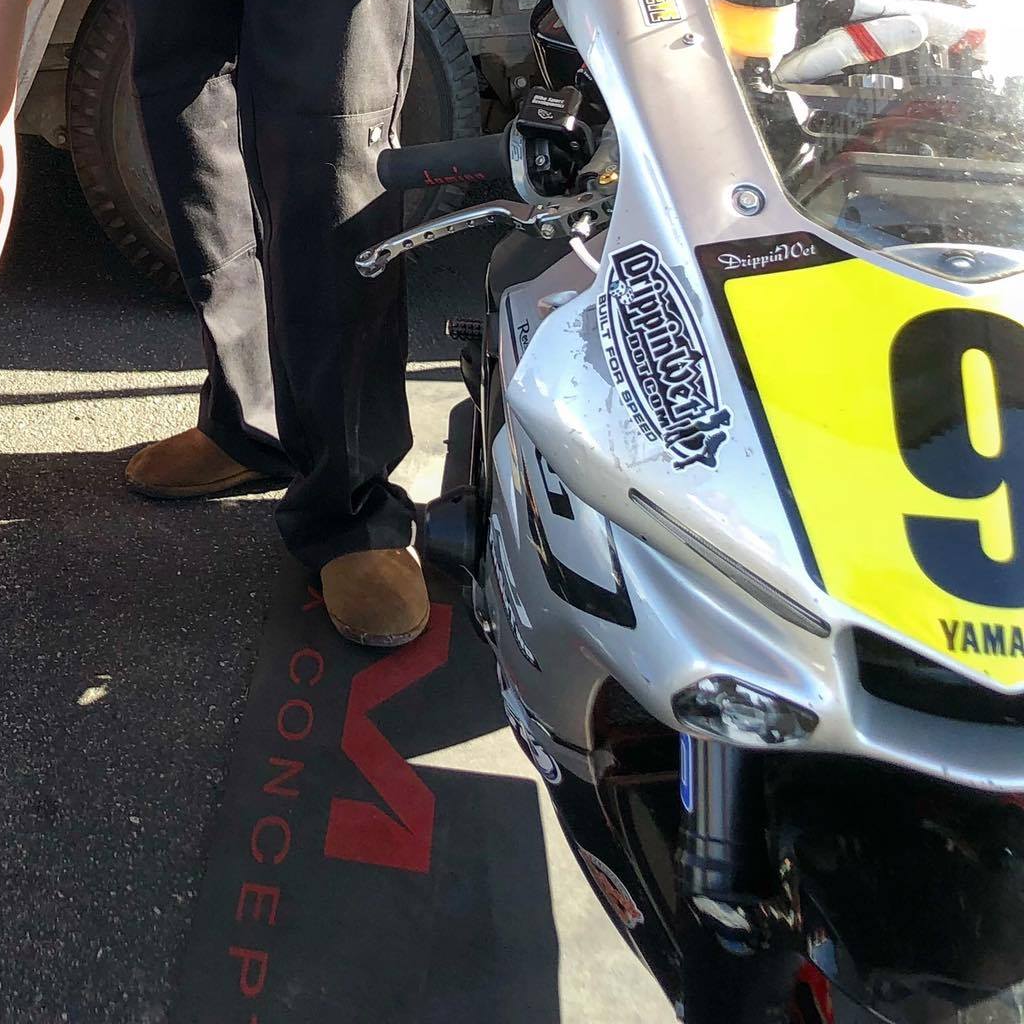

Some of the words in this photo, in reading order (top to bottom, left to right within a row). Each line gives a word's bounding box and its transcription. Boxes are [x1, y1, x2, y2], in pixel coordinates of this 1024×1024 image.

[717, 241, 817, 270] DrippinWet
[598, 295, 612, 340] BUILT
[605, 347, 624, 385] FOR
[621, 389, 658, 443] SPEED
[627, 333, 652, 377] DOT
[642, 378, 673, 429] COM
[228, 646, 325, 1024] CONCEP
